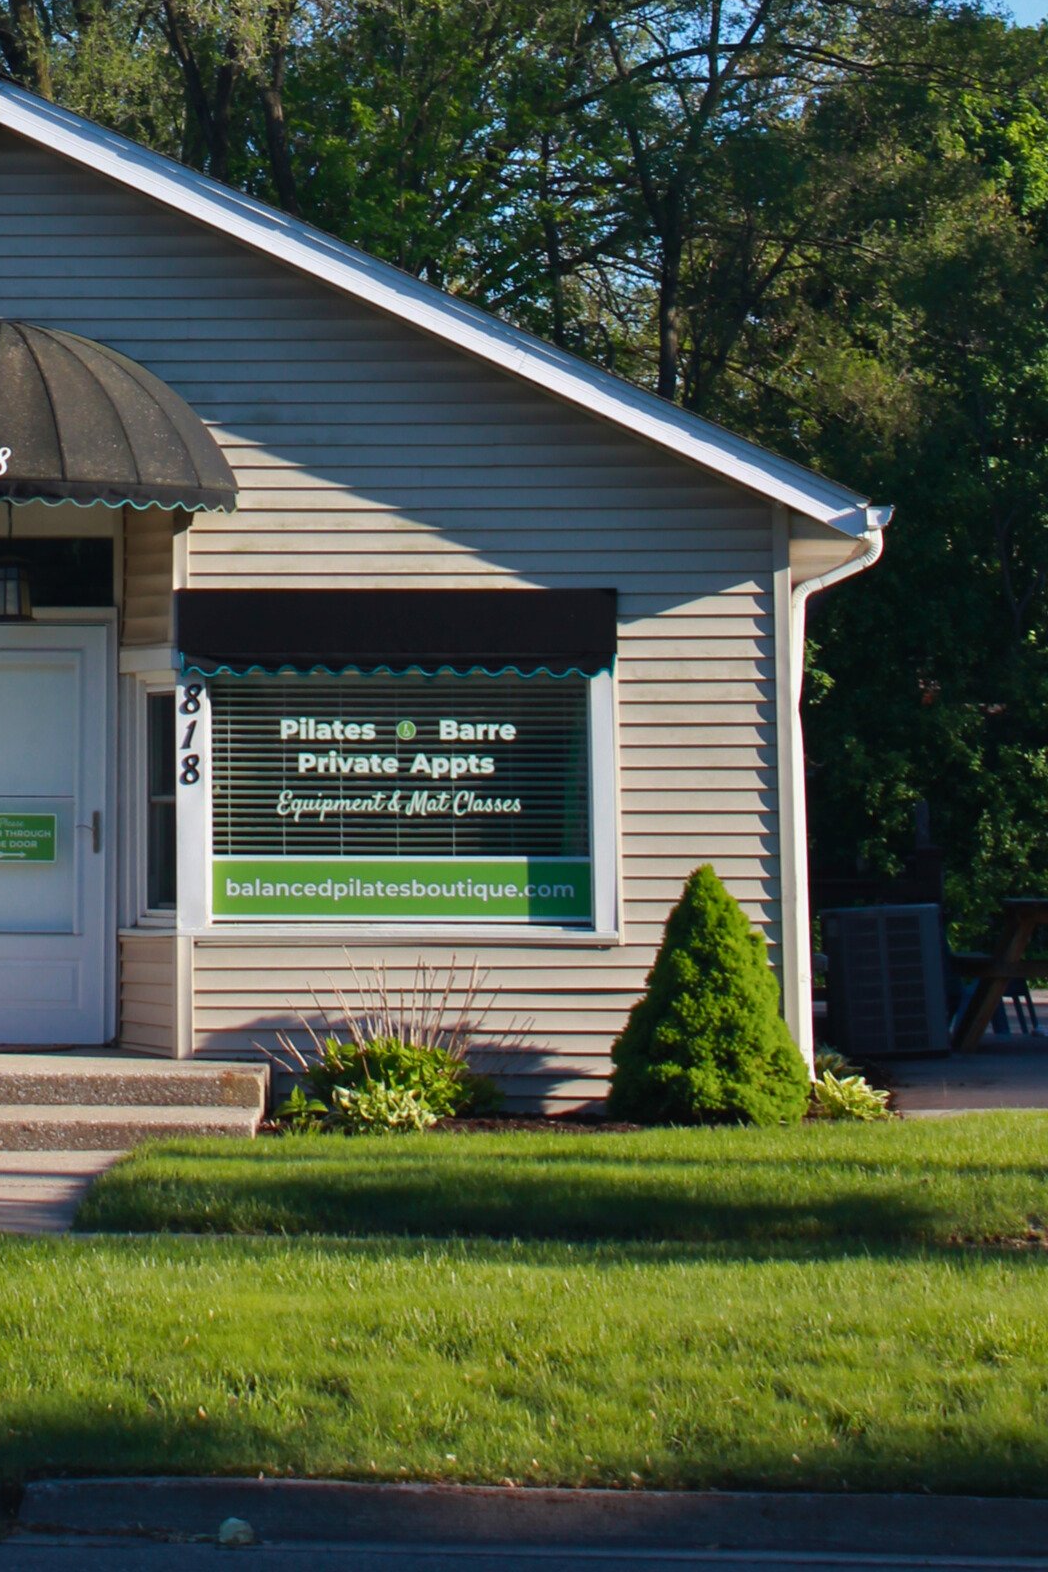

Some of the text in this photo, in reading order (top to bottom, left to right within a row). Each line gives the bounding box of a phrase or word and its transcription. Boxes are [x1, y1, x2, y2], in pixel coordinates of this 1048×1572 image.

[179, 683, 203, 785] 818
[279, 718, 517, 741] Pilates Barre
[298, 750, 495, 779] Private Appts
[277, 789, 522, 822] Equipment & Mat Classes
[5, 829, 52, 838] THROUGH
[9, 839, 38, 848] DOOR
[226, 877, 575, 901] balancedpilatesboutique.com
